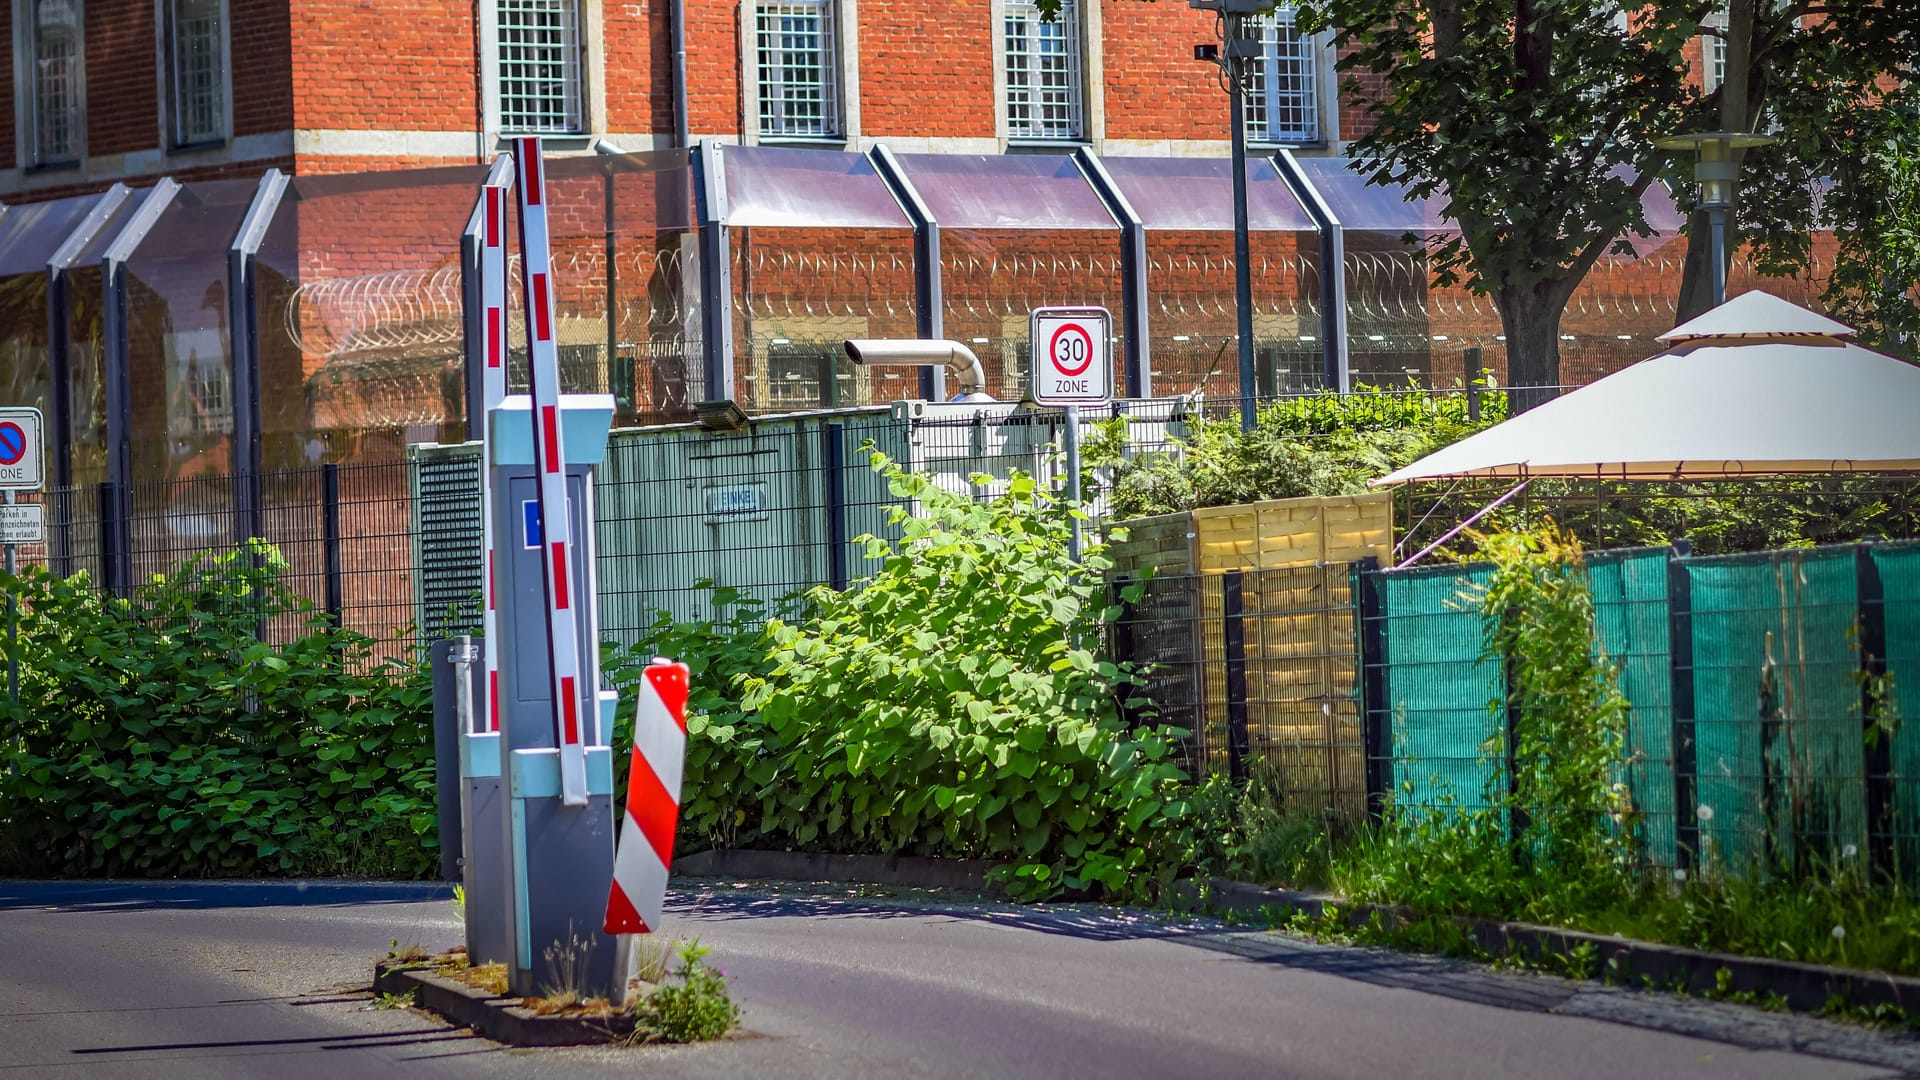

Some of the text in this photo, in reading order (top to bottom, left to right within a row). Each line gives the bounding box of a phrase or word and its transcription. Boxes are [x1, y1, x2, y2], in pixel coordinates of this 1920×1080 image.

[1059, 338, 1083, 361] 30
[1056, 380, 1088, 392] ZONE
[0, 468, 24, 479] ONE
[0, 520, 40, 529] nnzeichneten
